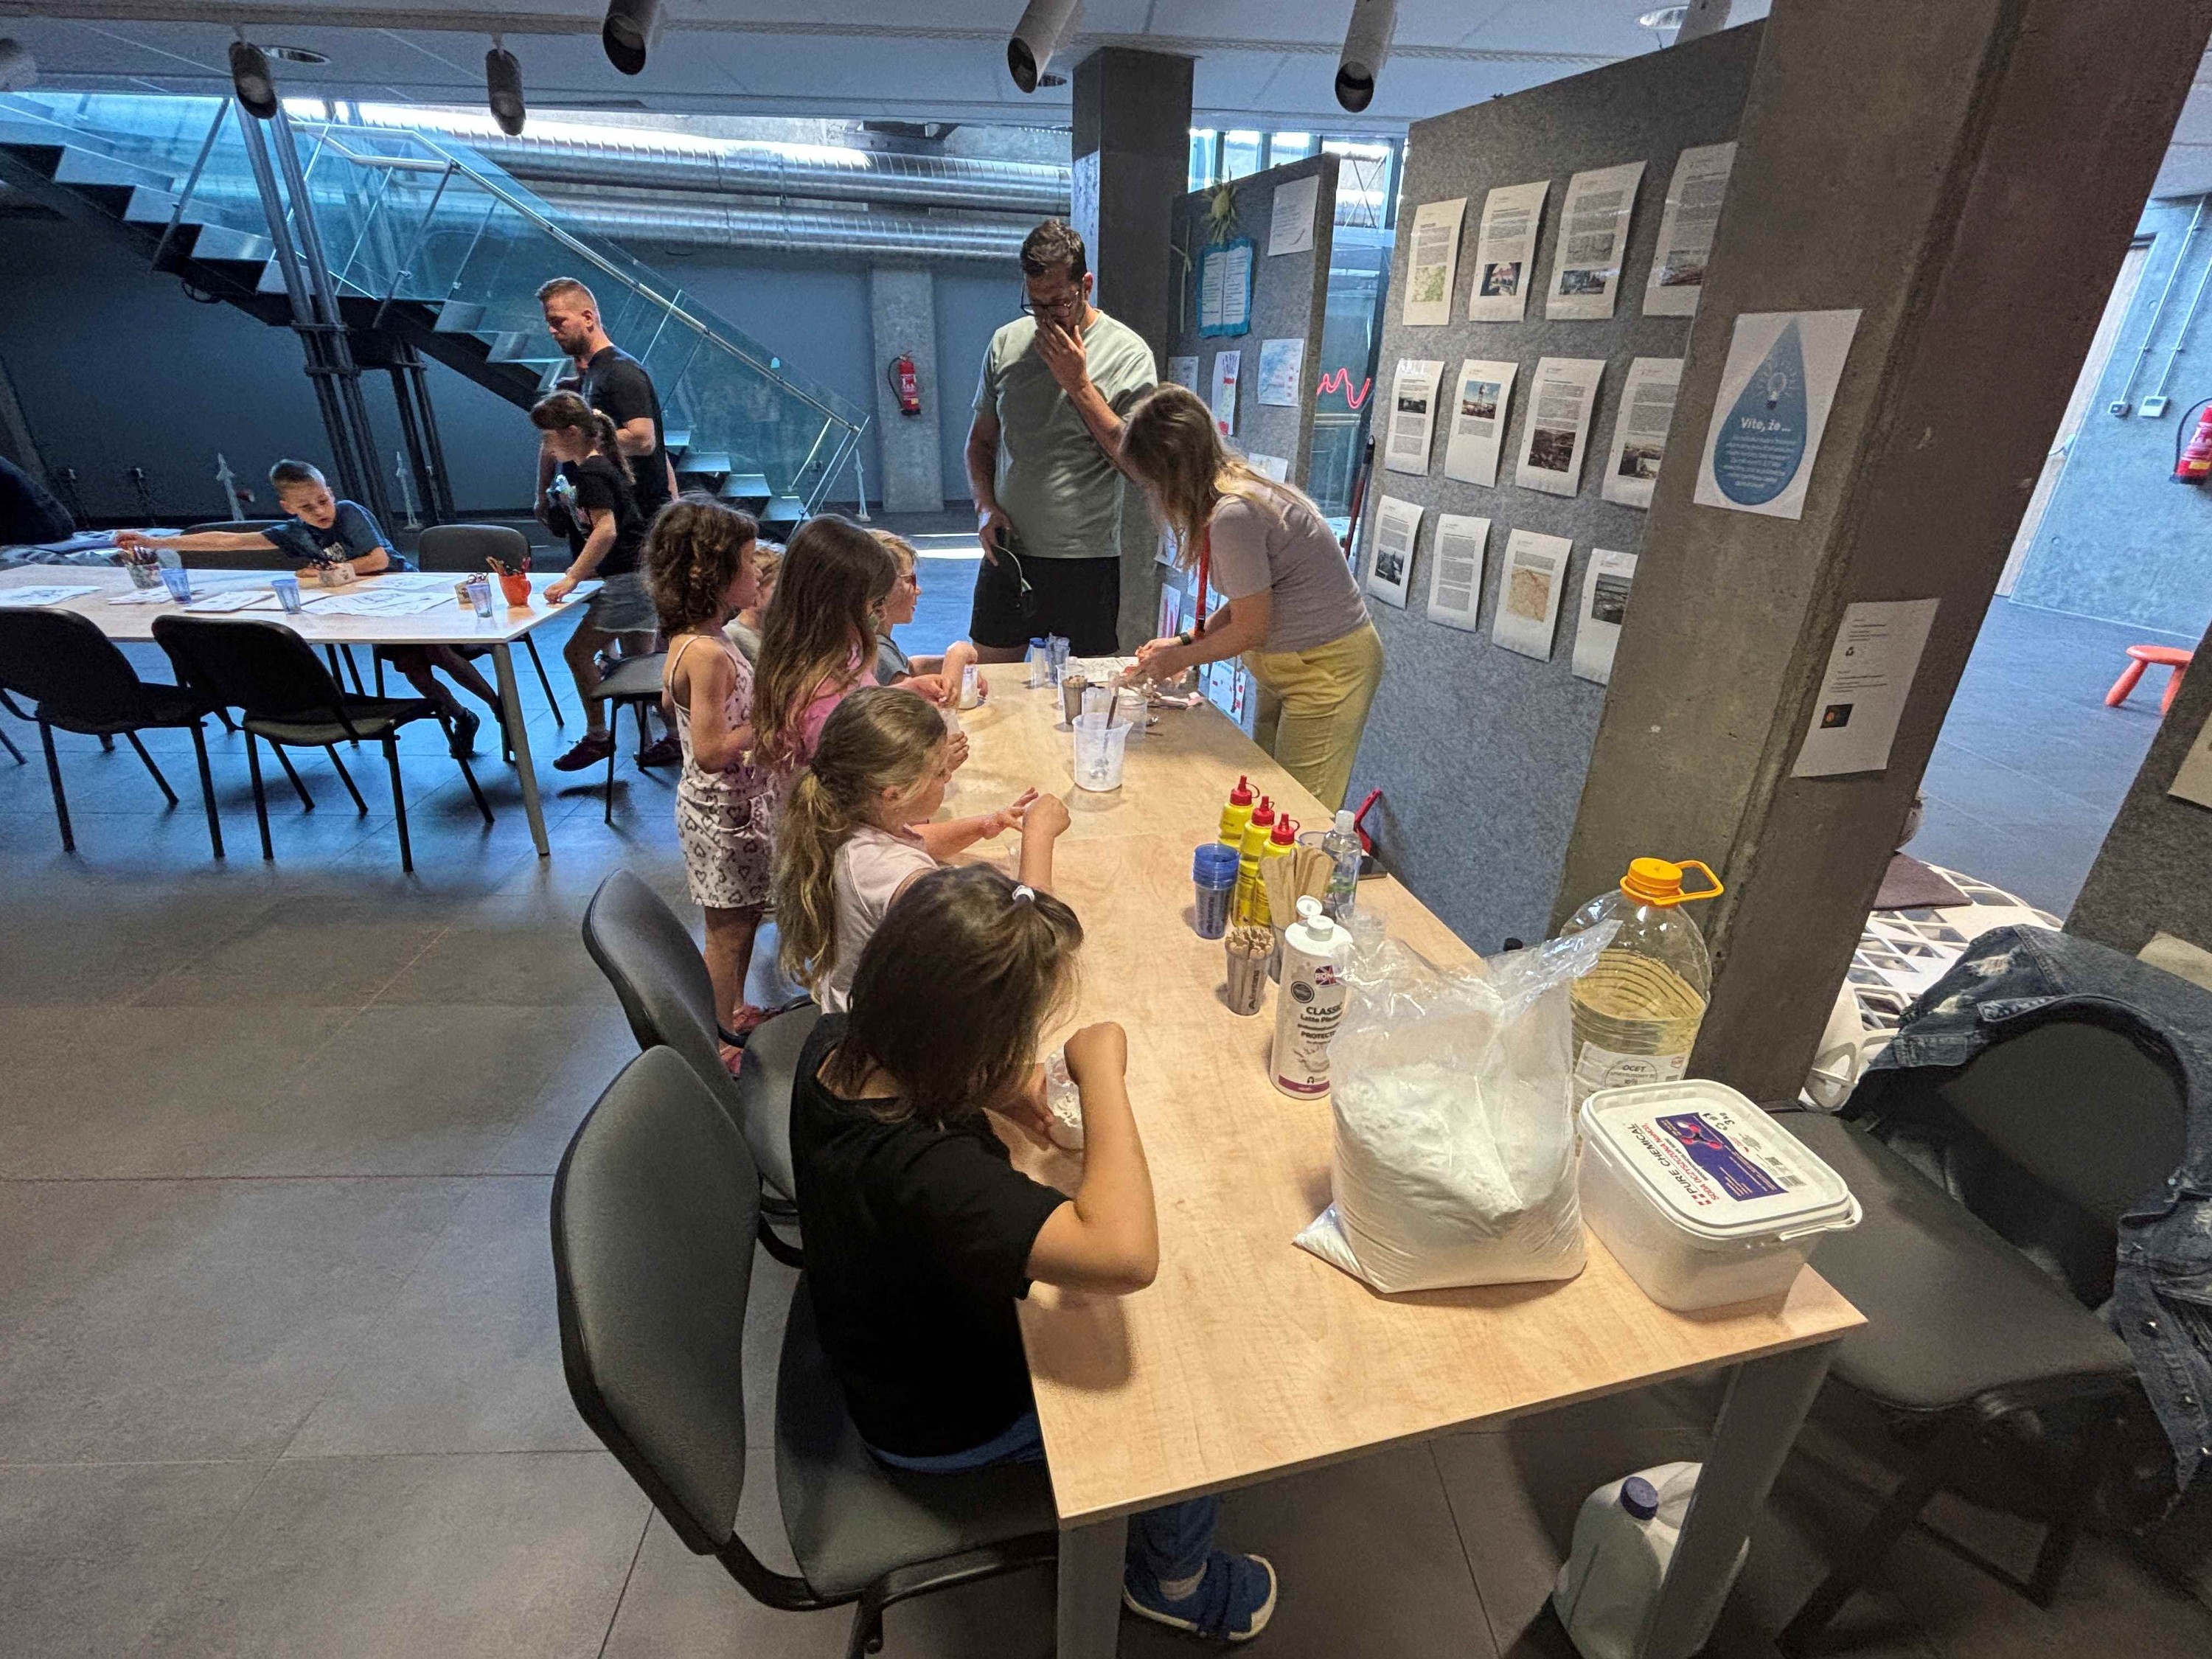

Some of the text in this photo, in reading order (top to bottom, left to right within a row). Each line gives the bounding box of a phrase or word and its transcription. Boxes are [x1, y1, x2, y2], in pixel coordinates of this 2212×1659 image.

[1627, 1123, 1671, 1166] CHEMICAL
[1668, 1169, 1697, 1194] PURE
[1700, 1183, 1719, 1200] SODA
